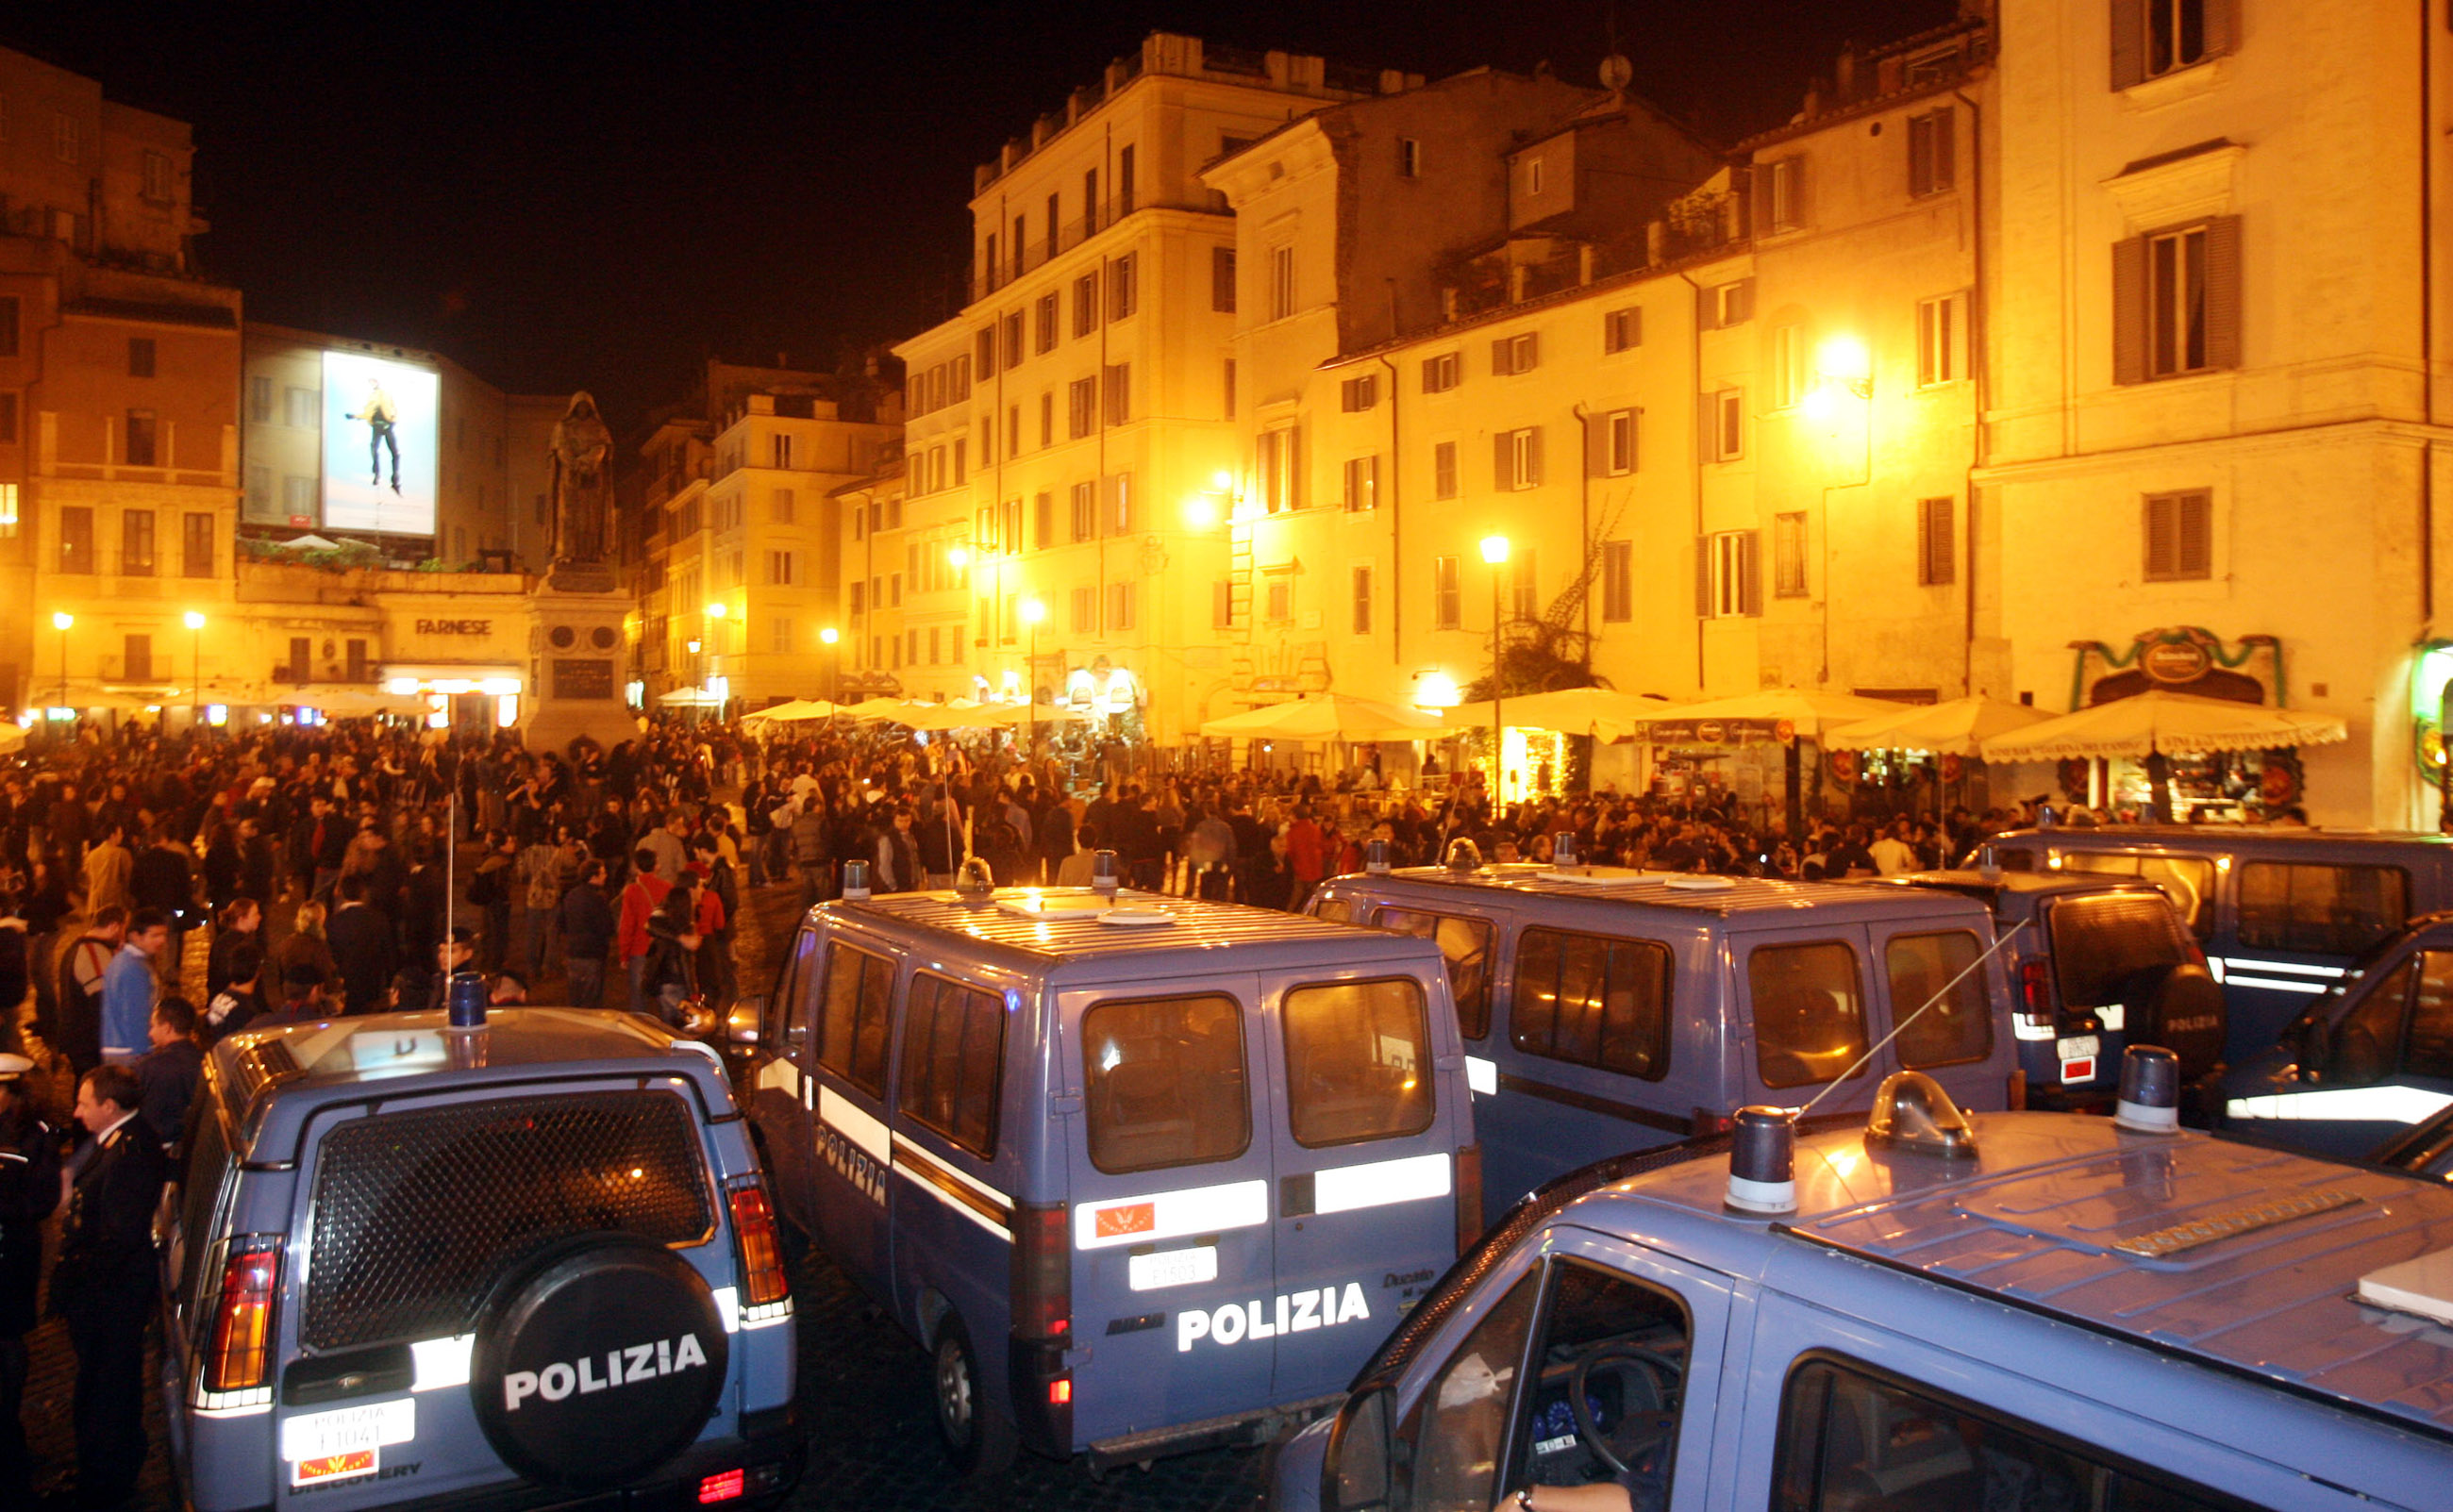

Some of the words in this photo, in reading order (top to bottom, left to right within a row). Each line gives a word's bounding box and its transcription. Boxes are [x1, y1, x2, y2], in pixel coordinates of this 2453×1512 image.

[415, 618, 492, 635] FARNESE
[816, 1124, 886, 1207] POLIZIA
[1177, 1282, 1370, 1353] POLIZIA
[505, 1333, 708, 1412] POLIZIA
